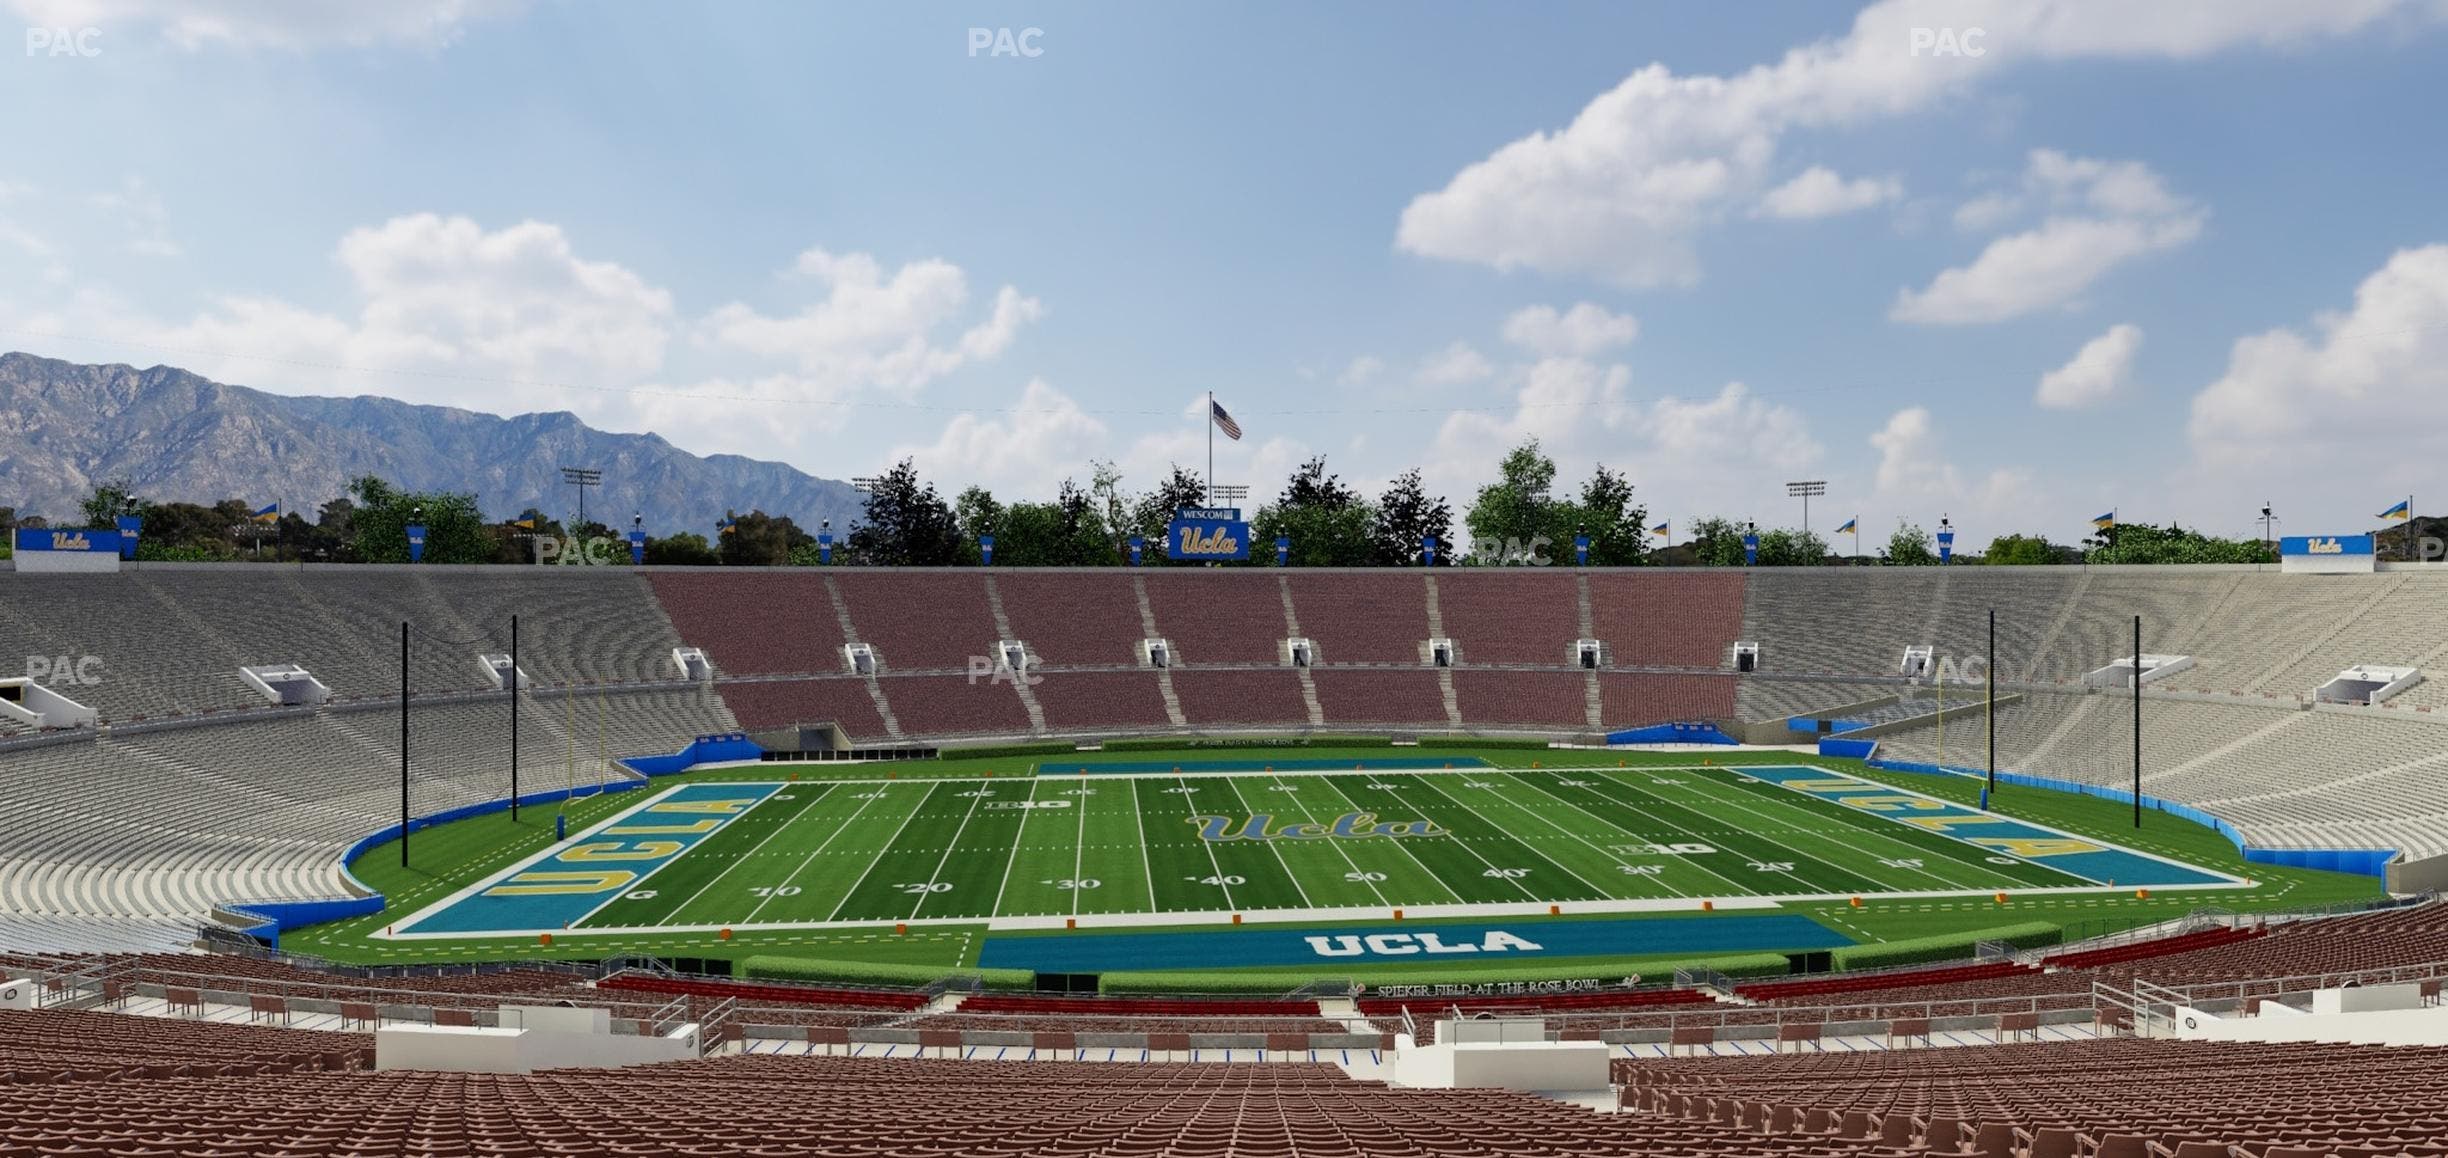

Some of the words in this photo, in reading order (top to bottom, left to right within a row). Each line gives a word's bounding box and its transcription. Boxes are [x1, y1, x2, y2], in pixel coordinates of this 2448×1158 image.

[1183, 510, 1222, 519] WESCOM
[1180, 527, 1238, 554] Ucla
[1780, 779, 2113, 858] UCLA
[1184, 812, 1451, 841] Ucla
[481, 798, 757, 896] UCLA
[1482, 868, 1529, 878] 40
[1616, 866, 1662, 875] 30
[1200, 875, 1246, 886] 40
[1344, 872, 1388, 882] 50
[903, 883, 954, 893] 20
[1057, 879, 1101, 889] 30
[757, 886, 802, 897] 10
[1304, 930, 1544, 956] UCLA
[1378, 985, 1430, 997] SPIEKER
[1434, 984, 1471, 995] FIELD
[1475, 983, 1493, 995] AT
[1497, 982, 1525, 994] THE
[1529, 980, 1562, 992] ROSE
[1566, 979, 1599, 990] BOWL
